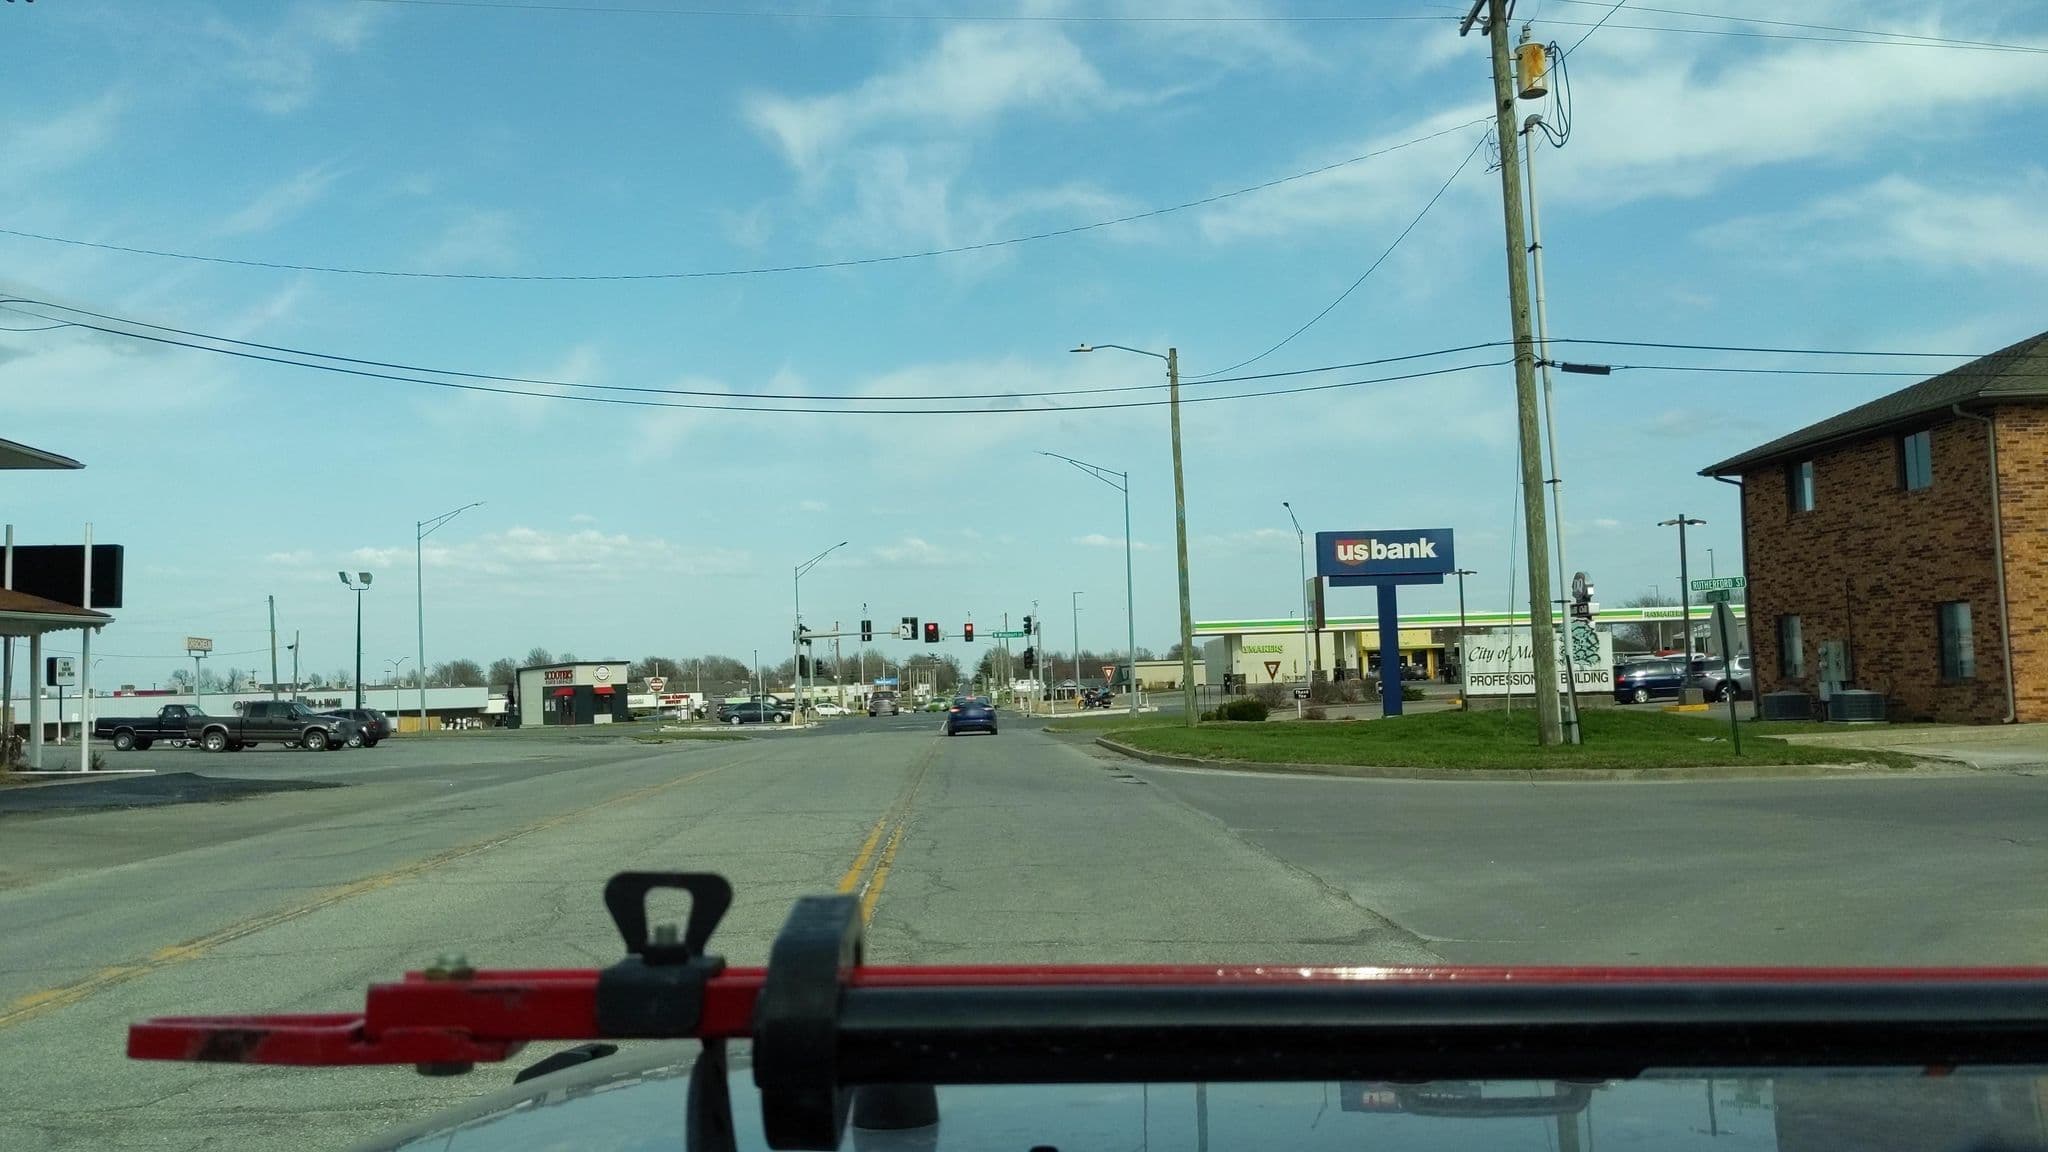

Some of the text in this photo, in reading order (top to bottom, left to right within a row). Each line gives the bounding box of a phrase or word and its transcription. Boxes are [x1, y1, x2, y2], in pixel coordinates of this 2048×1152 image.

[1692, 577, 1744, 590] RUTHERFORD ST
[1468, 646, 1494, 663] City
[1510, 645, 1535, 661] Ma
[1470, 671, 1609, 686] PROFESSION BILDING
